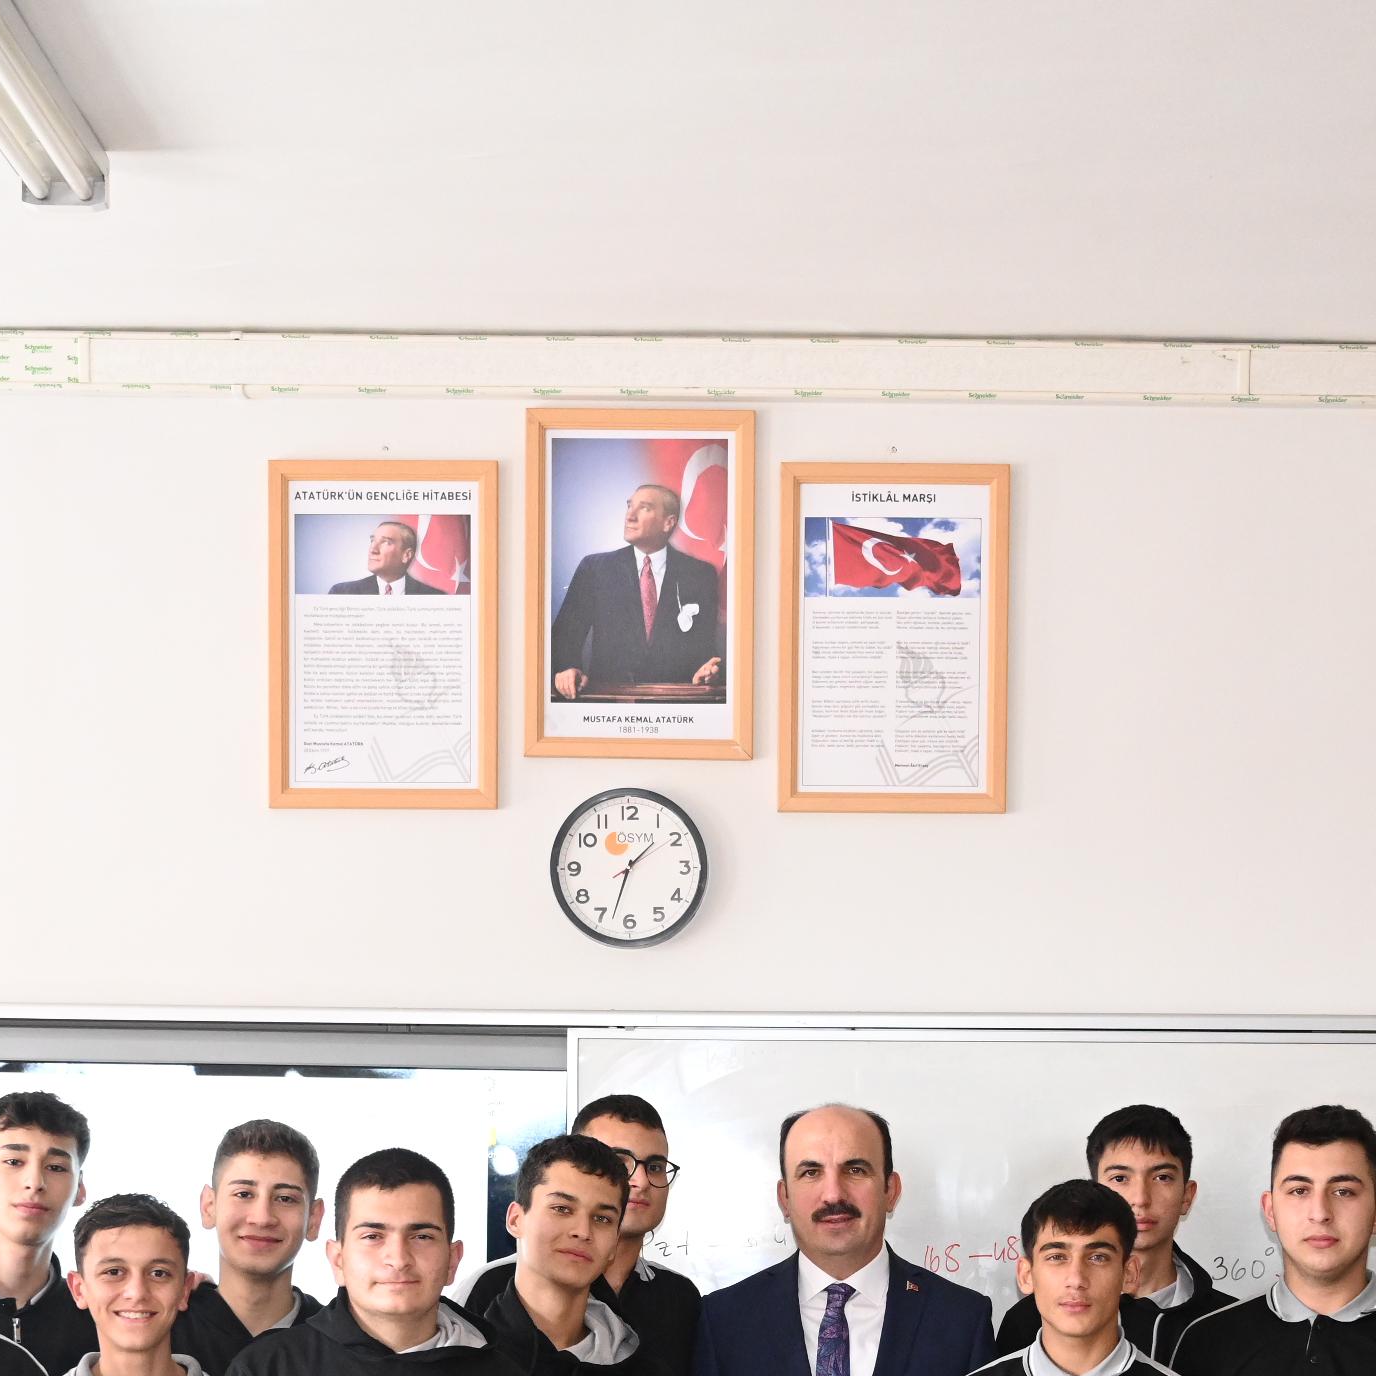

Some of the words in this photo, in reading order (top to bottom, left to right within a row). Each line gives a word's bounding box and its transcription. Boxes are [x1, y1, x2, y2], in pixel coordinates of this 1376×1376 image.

[294, 489, 363, 501] ATATÜRK'ÜN
[366, 489, 419, 502] GENÇLİĞE
[423, 489, 472, 501] HİTABESİ
[851, 490, 899, 503] İSTİKLÂL
[903, 493, 936, 504] MARŞI
[583, 715, 622, 723] MUSTAFA
[656, 715, 694, 724] ATATÜRK
[619, 726, 659, 734] 1881-1938
[621, 805, 639, 821] 12
[597, 814, 608, 829] 11
[578, 832, 598, 848] 10
[617, 831, 654, 843] ÖSYM
[669, 832, 683, 847] 2
[567, 861, 582, 877] 9
[679, 860, 691, 875] 3
[575, 888, 590, 904] 8
[670, 887, 683, 903] 4
[593, 907, 608, 923] 7
[652, 906, 666, 922] 5
[622, 914, 637, 930] 6
